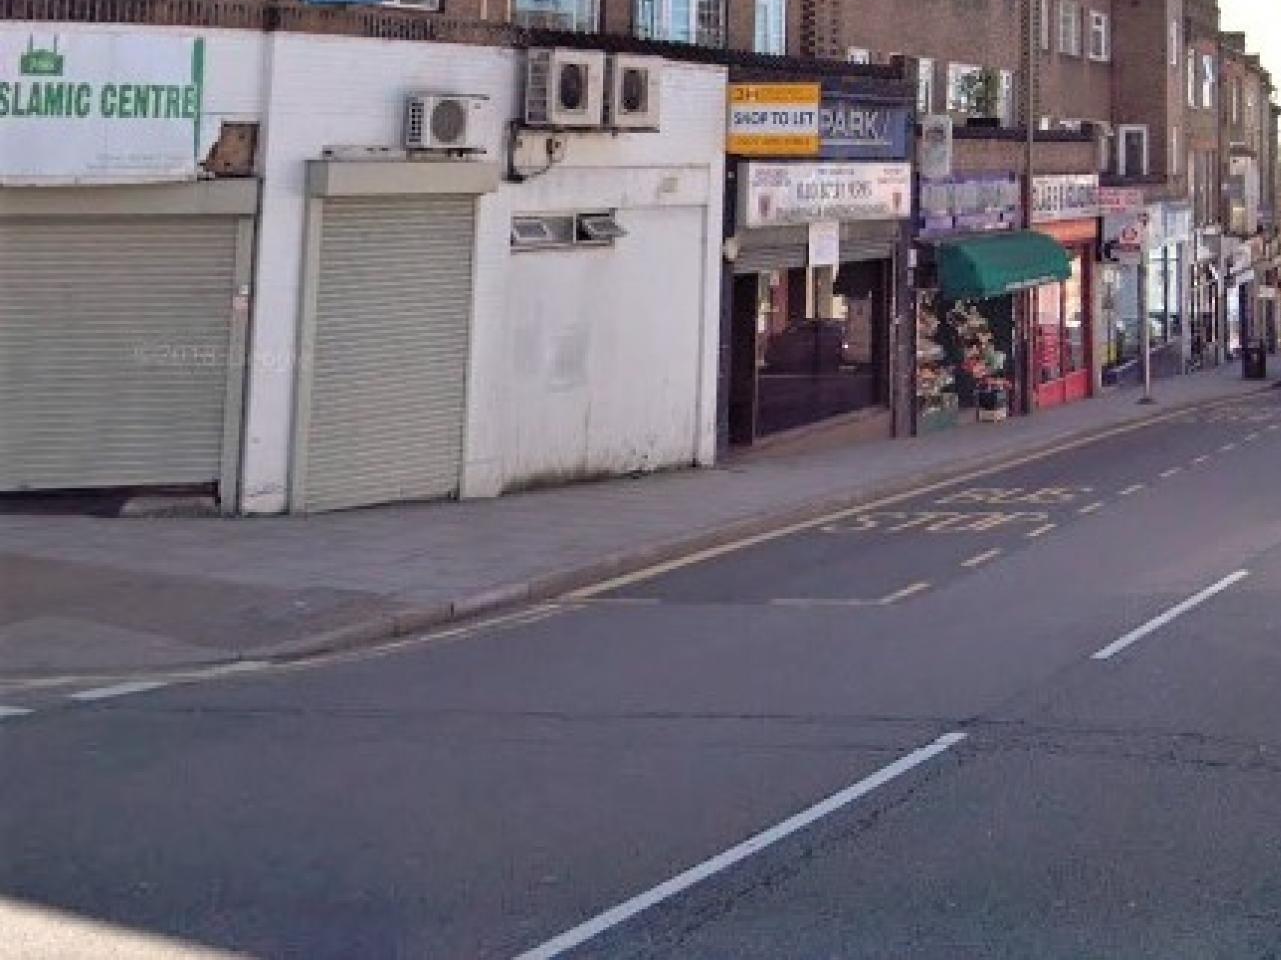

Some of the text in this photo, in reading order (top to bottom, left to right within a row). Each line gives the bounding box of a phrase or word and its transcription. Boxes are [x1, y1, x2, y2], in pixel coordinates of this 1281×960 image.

[100, 83, 196, 119] CENTRE
[733, 111, 815, 126] SHOP TO LET
[932, 482, 1094, 505] BUS
[816, 510, 1050, 532] STOP
